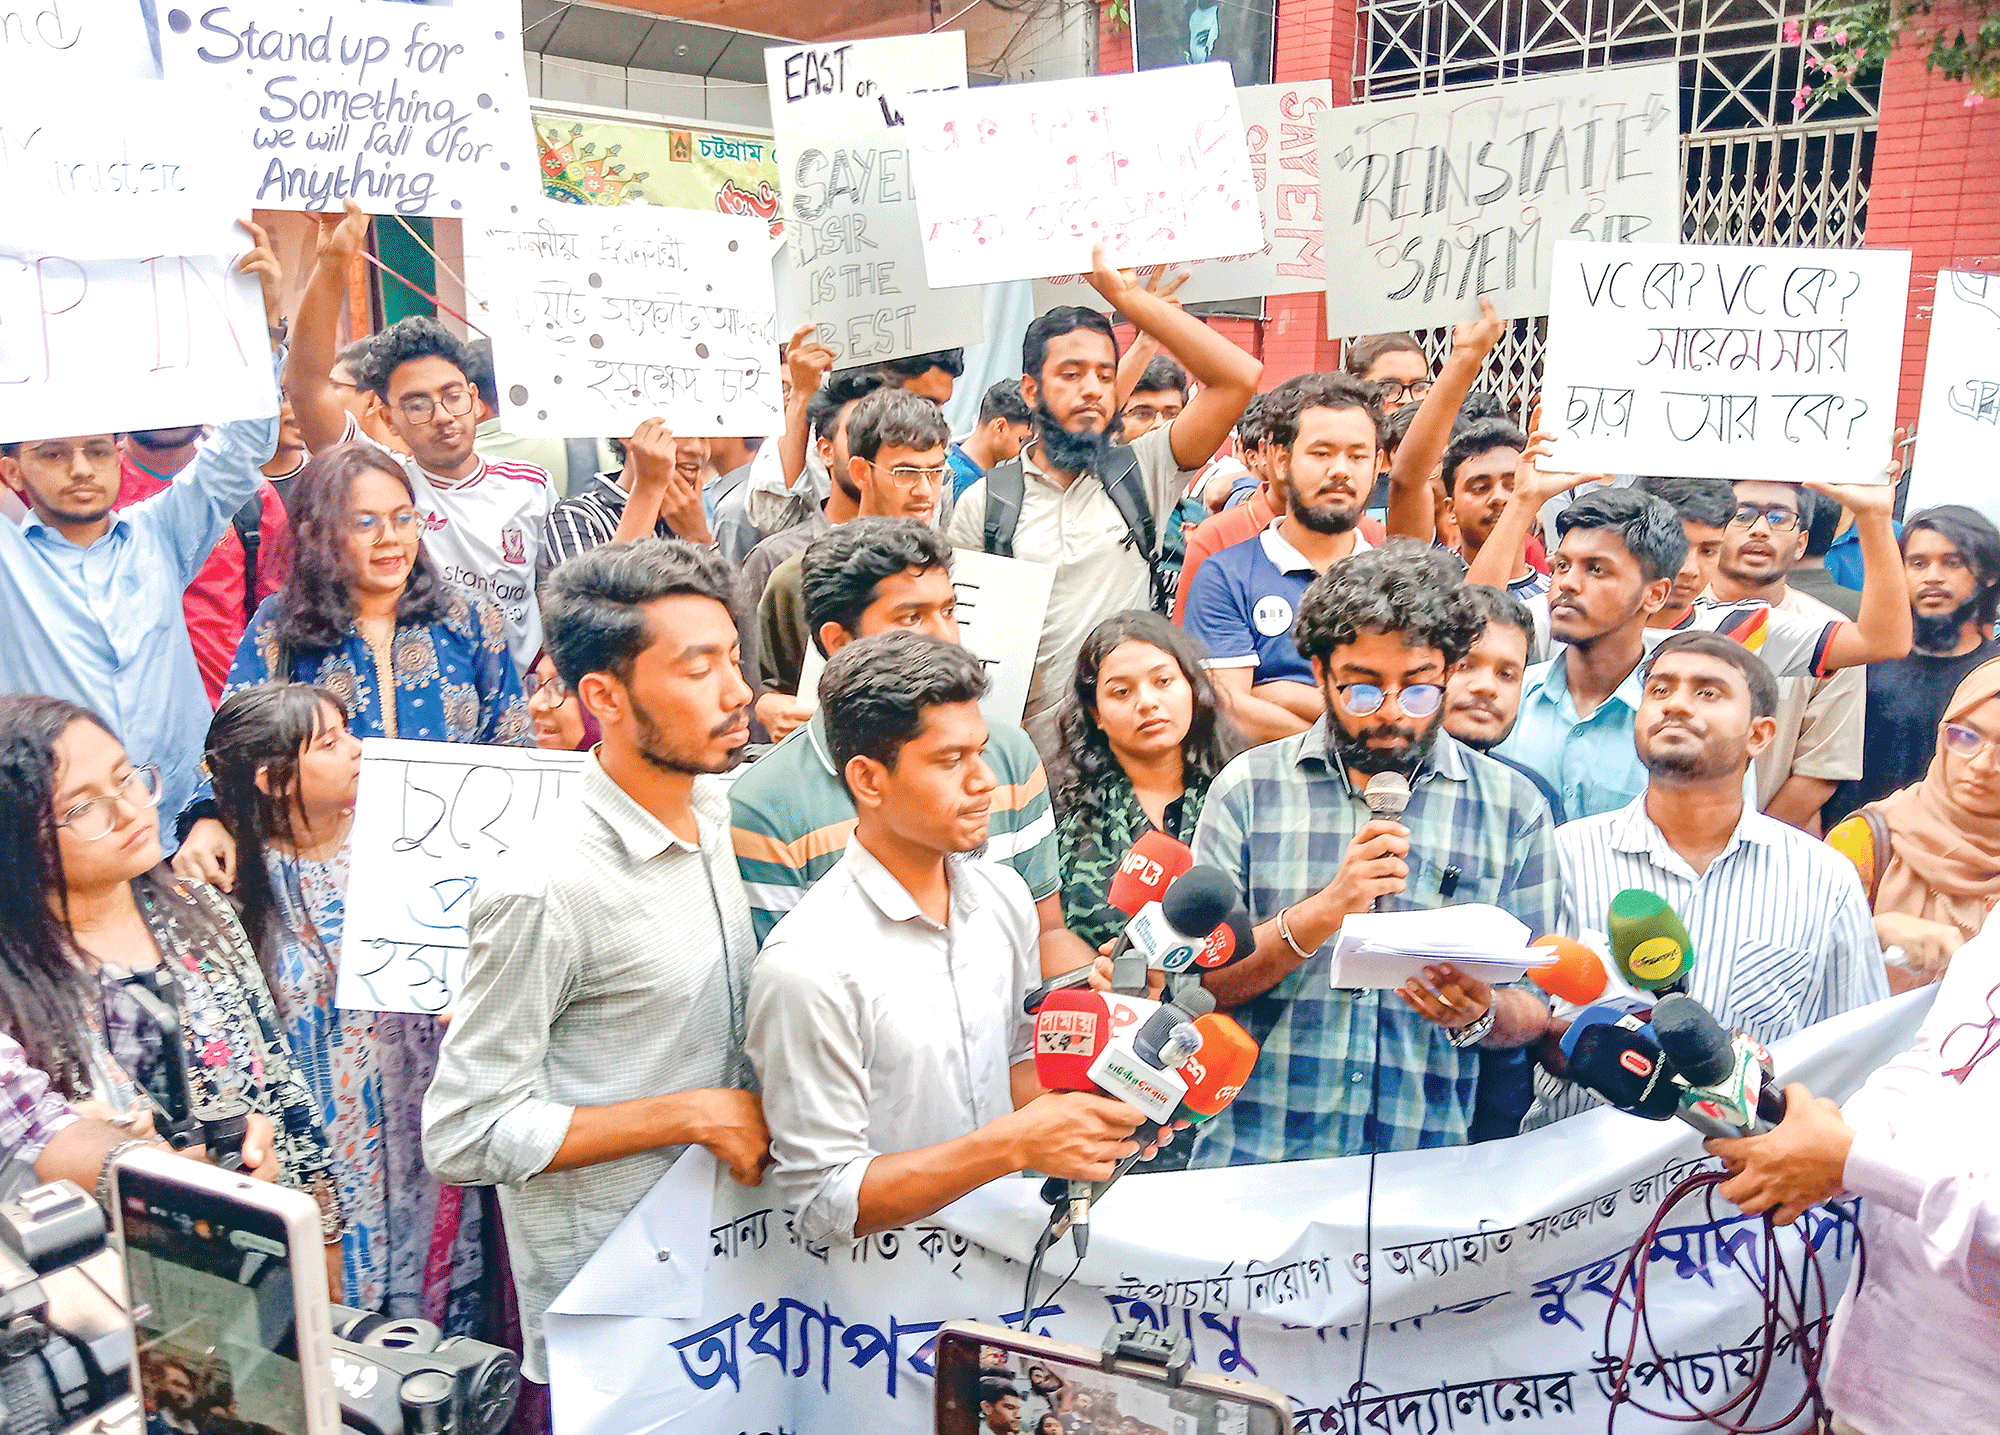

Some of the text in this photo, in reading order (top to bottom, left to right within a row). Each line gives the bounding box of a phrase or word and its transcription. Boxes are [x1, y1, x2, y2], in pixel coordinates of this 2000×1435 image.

[197, 6, 465, 86] Stand up for
[784, 44, 877, 103] EAST or
[253, 121, 494, 163] we will fall for
[259, 75, 473, 157] Something
[698, 135, 765, 164] চট্টগ্রাম
[256, 152, 440, 214] Anything
[1273, 91, 1327, 281] SAYEM
[839, 261, 902, 299] THE
[1386, 217, 1542, 304] SAYEM
[1580, 261, 1861, 322] VC কে? VC কে?
[815, 304, 917, 362] BEST
[1769, 328, 1849, 375] স্যার
[1565, 385, 1869, 451] ছাড়া আর কে?
[1243, 1259, 1333, 1312] নিয়োগ
[1381, 1218, 1517, 1281] অব্যাহতি
